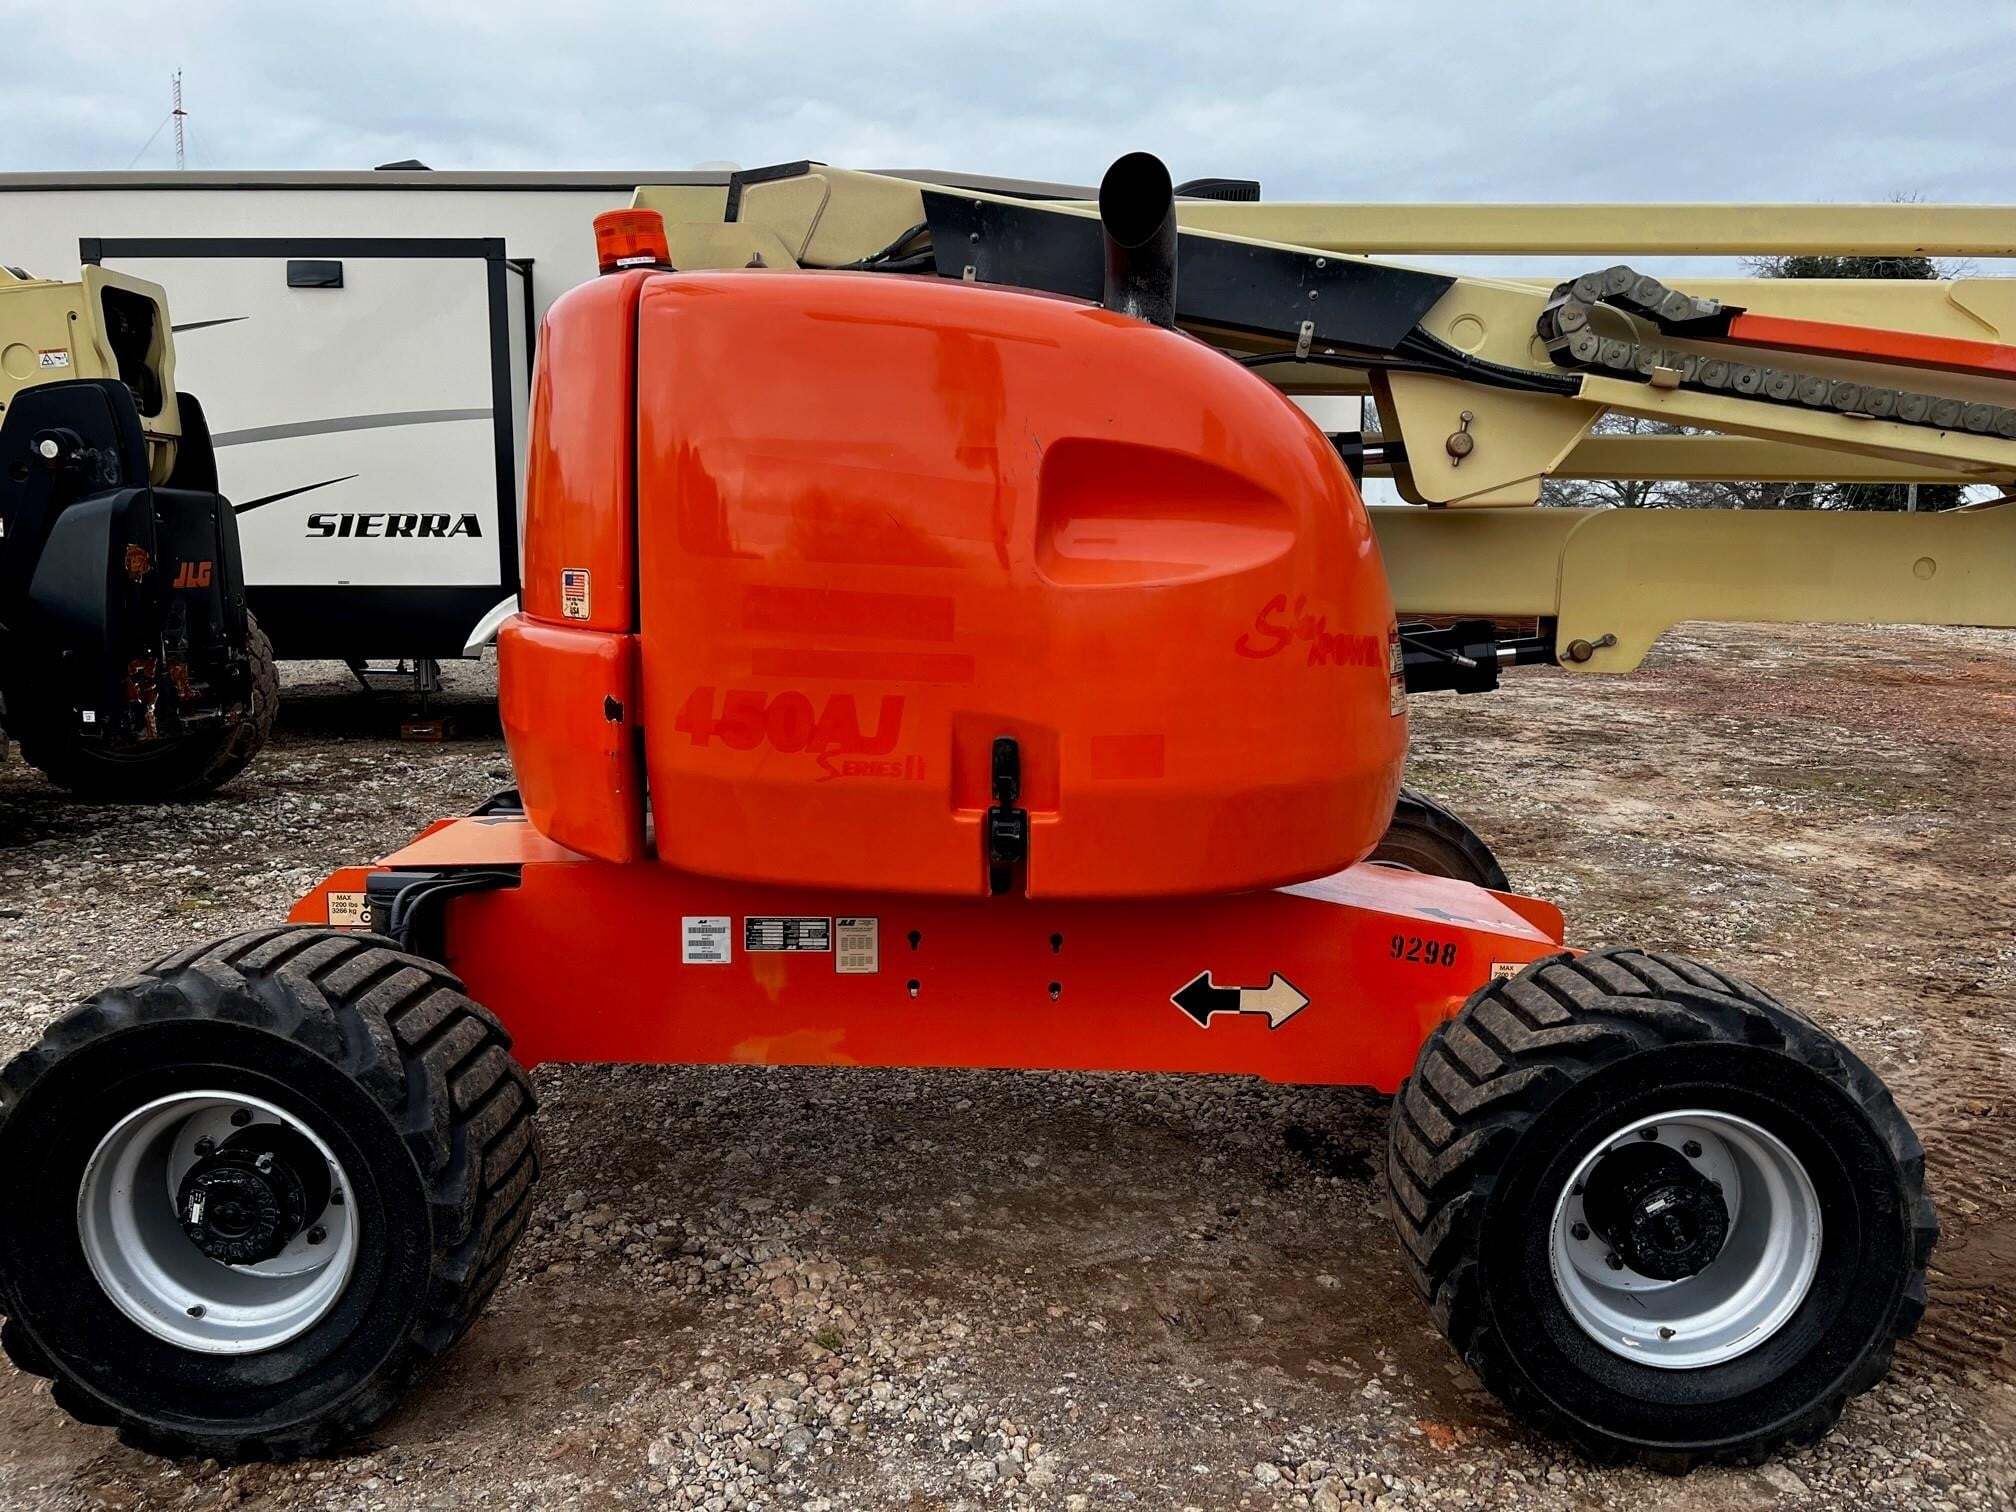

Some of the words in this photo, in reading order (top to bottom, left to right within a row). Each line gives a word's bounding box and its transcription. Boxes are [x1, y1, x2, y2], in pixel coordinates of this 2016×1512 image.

[305, 513, 483, 538] SIERRA
[173, 561, 212, 588] JLG
[674, 685, 906, 756] 450AJ
[1390, 934, 1457, 968] 9298
